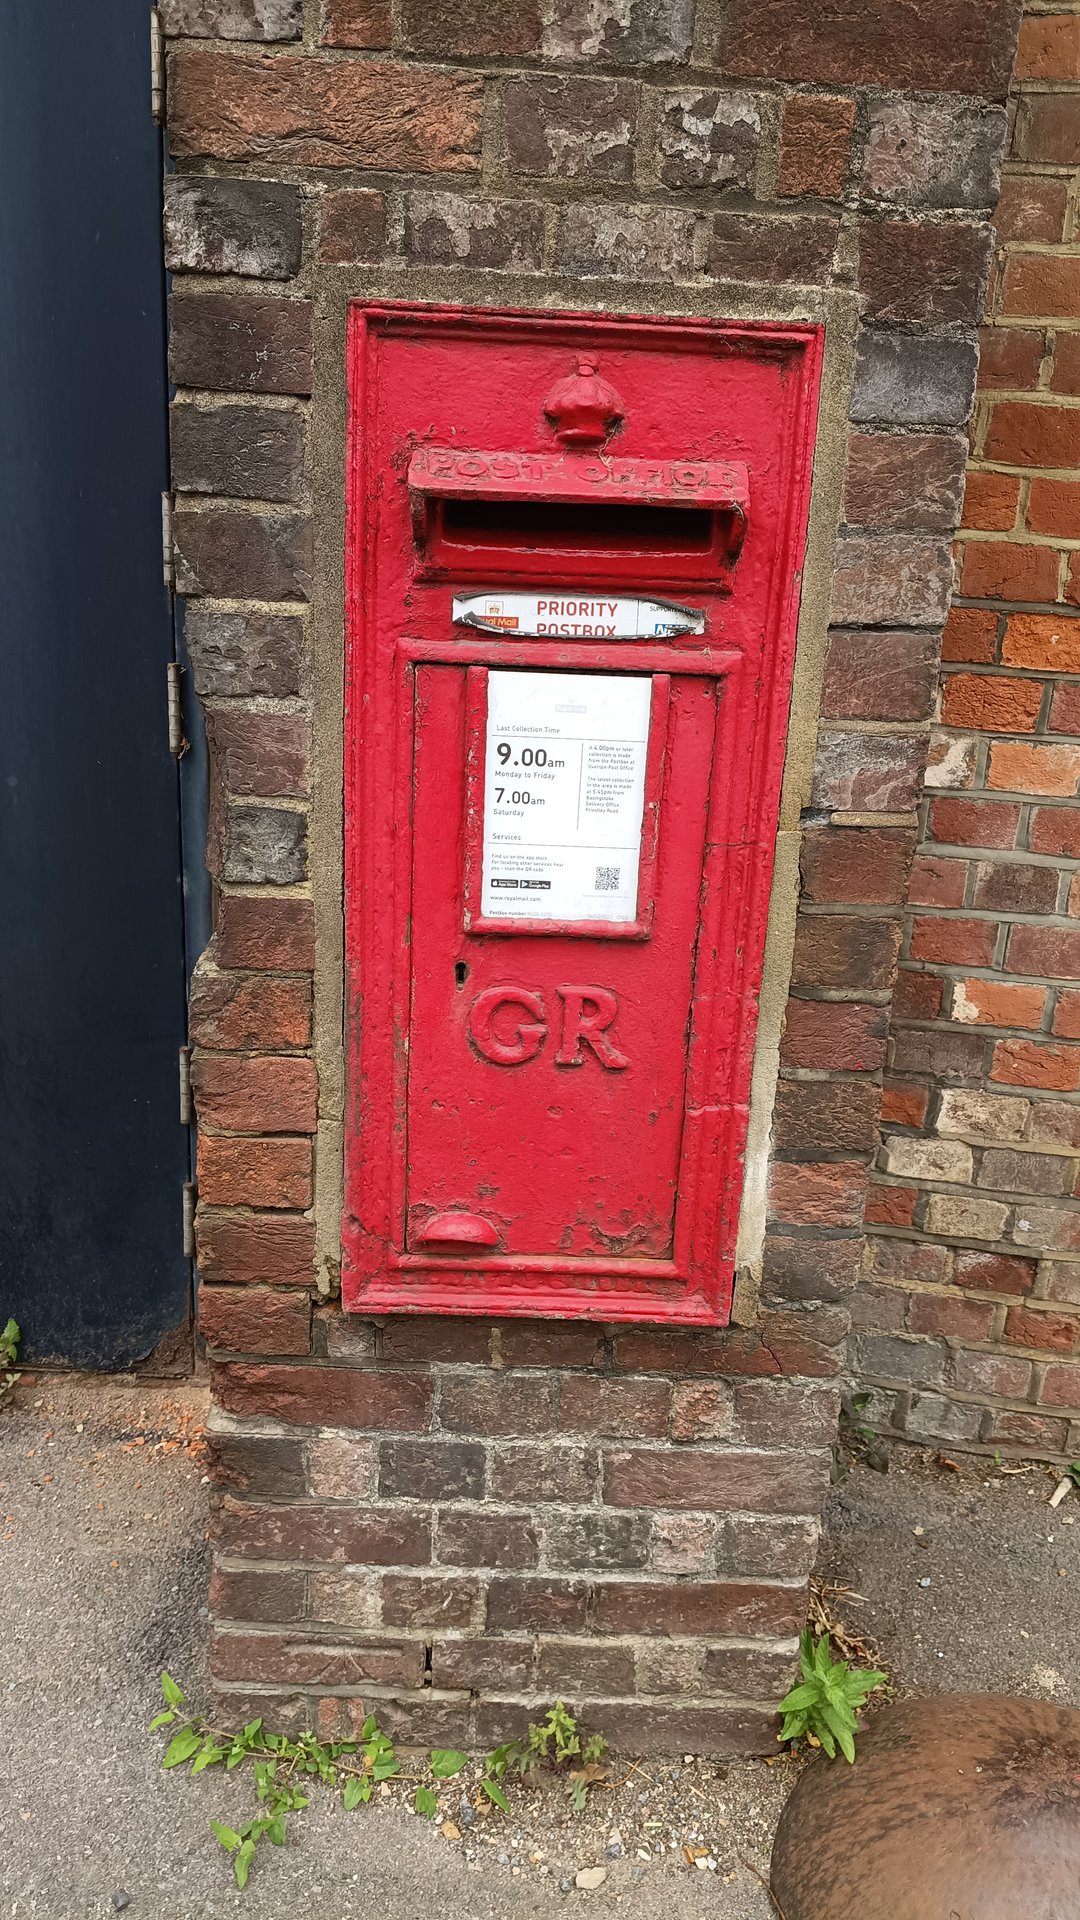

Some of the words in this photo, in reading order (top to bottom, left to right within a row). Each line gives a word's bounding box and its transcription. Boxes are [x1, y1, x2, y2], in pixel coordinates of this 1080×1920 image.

[428, 452, 551, 480] POST
[575, 464, 734, 490] OFFICE
[537, 601, 618, 617] PRIORITY
[497, 618, 517, 627] Mail
[537, 623, 616, 637] POSTBOX
[497, 724, 510, 732] Last
[512, 725, 543, 733] Collection
[544, 726, 560, 734] Time
[497, 742, 565, 768] 9.00am
[494, 770, 522, 779] Monday
[533, 772, 556, 780] Friday
[494, 787, 546, 805] 7.00am
[493, 808, 525, 818] Saturday
[492, 832, 522, 841] Services
[469, 984, 631, 1071] GR
